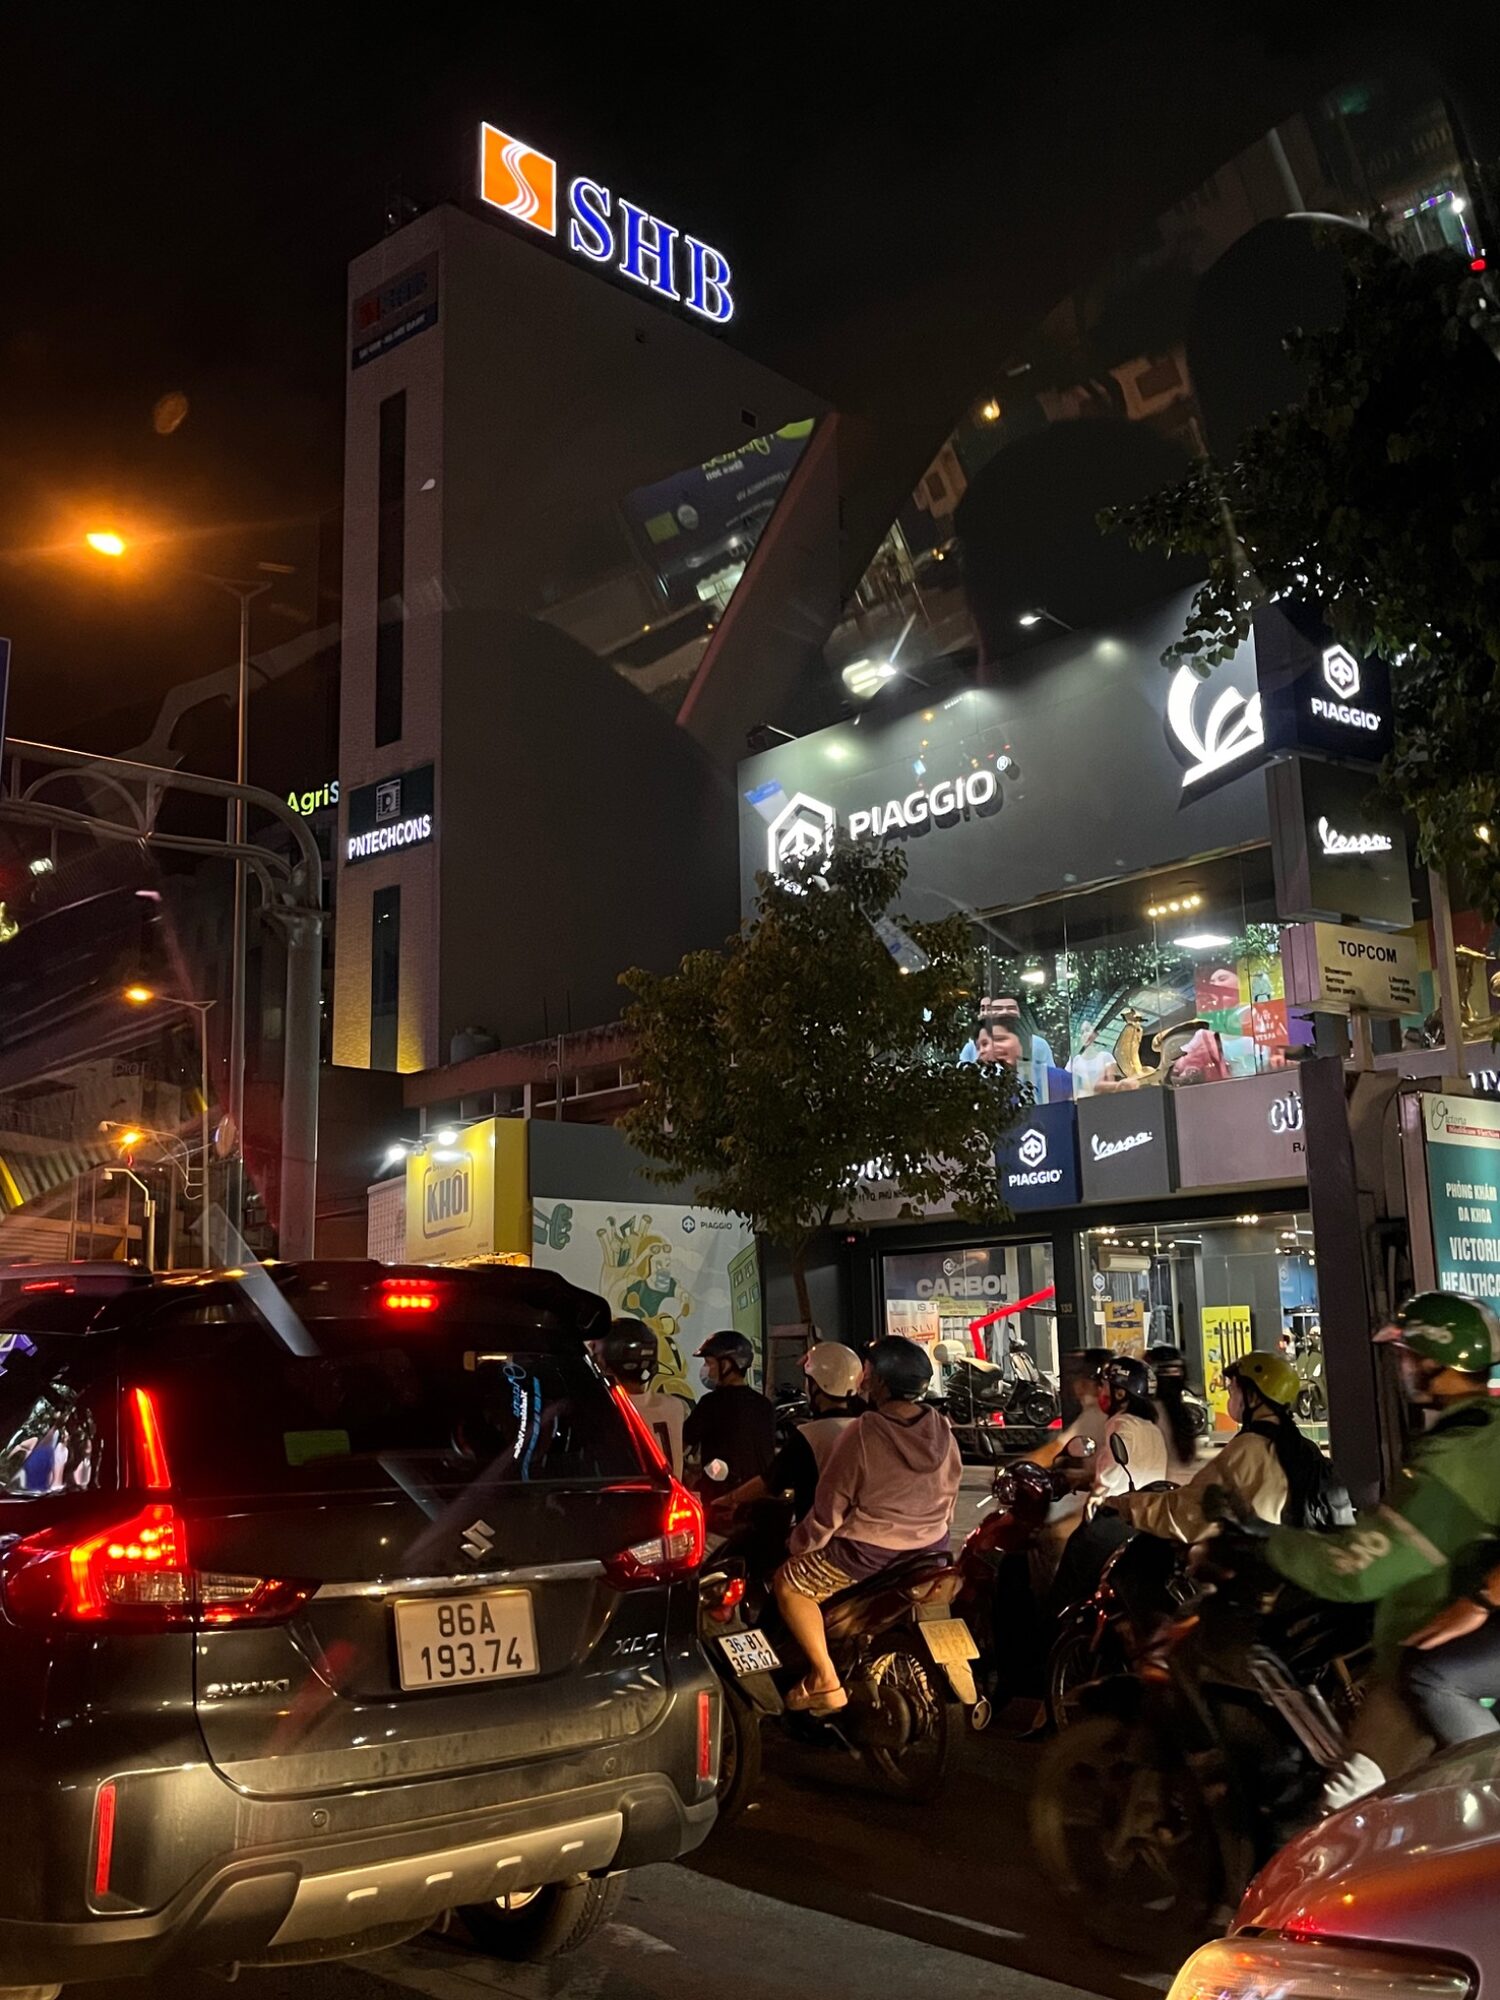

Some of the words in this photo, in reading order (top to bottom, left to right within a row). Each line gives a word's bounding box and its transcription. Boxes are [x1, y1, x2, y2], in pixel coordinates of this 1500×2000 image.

[570, 177, 734, 323] SHB
[1311, 697, 1381, 731] PIAGGIO
[849, 770, 997, 841] PIAGGIO
[348, 814, 431, 860] PNTECHCONS
[1318, 816, 1392, 854] Vespa
[1338, 940, 1397, 963] TOPCOM
[1091, 1131, 1154, 1161] Vespa
[1008, 1169, 1063, 1187] PIAGGIO
[1445, 1180, 1473, 1199] PHÒNG
[1473, 1183, 1498, 1201] KHÁM
[427, 1169, 469, 1223] KHÔI
[700, 1220, 732, 1231] PIAGGIO
[1470, 1207, 1492, 1224] KHOA
[438, 1601, 496, 1637] 86A
[421, 1637, 522, 1680] 193.74
